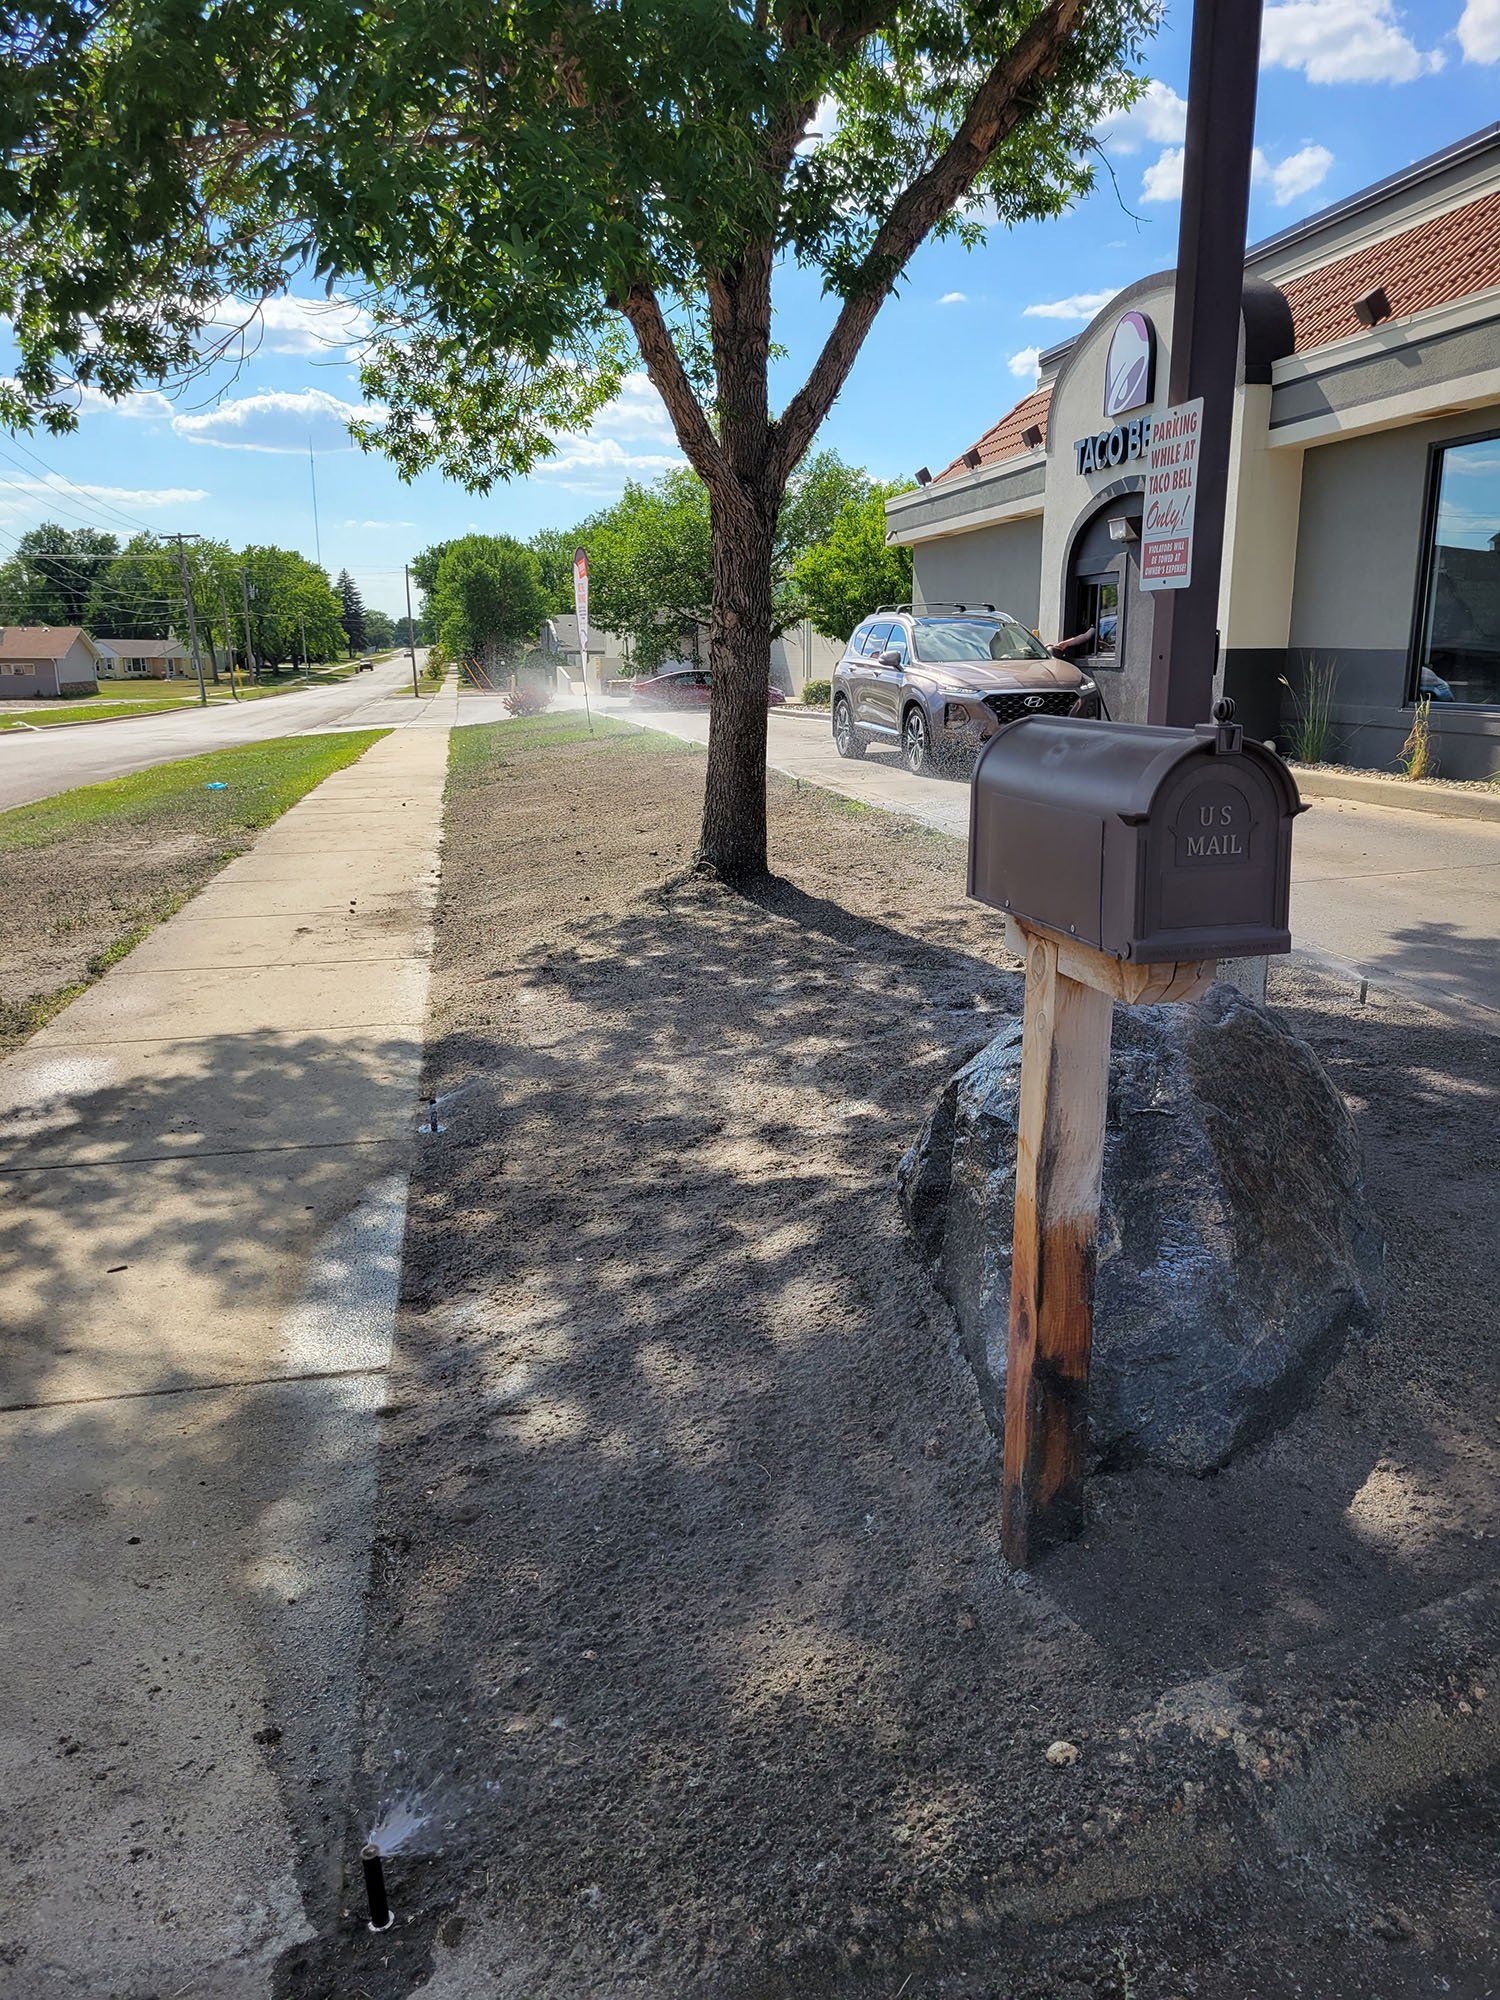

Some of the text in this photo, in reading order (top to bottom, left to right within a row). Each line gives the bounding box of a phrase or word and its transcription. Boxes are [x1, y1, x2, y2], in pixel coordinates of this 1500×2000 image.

[1153, 411, 1197, 443] PARKING
[1074, 416, 1152, 476] TACO BE
[1152, 439, 1195, 469] WHILE AT
[1149, 467, 1192, 495] TACO BELL
[1147, 495, 1191, 536] Only!
[1187, 834, 1242, 857] MAIL
